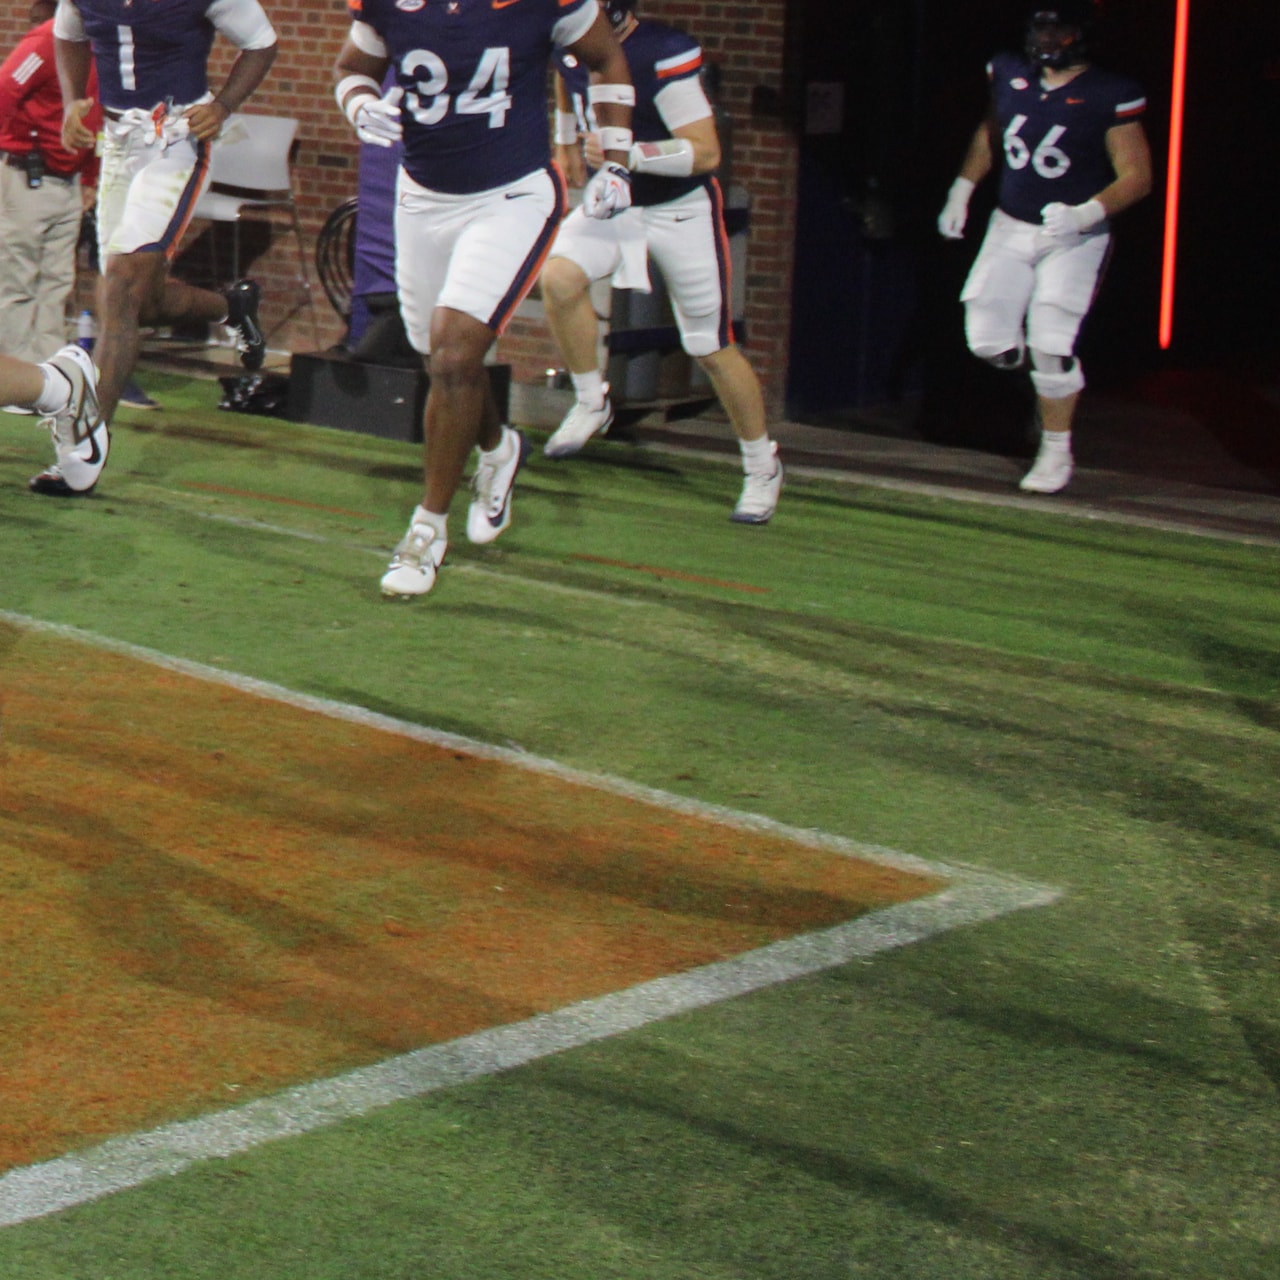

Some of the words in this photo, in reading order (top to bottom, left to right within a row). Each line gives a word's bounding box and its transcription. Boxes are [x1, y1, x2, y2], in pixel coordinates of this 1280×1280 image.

[116, 24, 137, 91] 1
[400, 47, 513, 129] 34
[1003, 113, 1071, 179] 66
